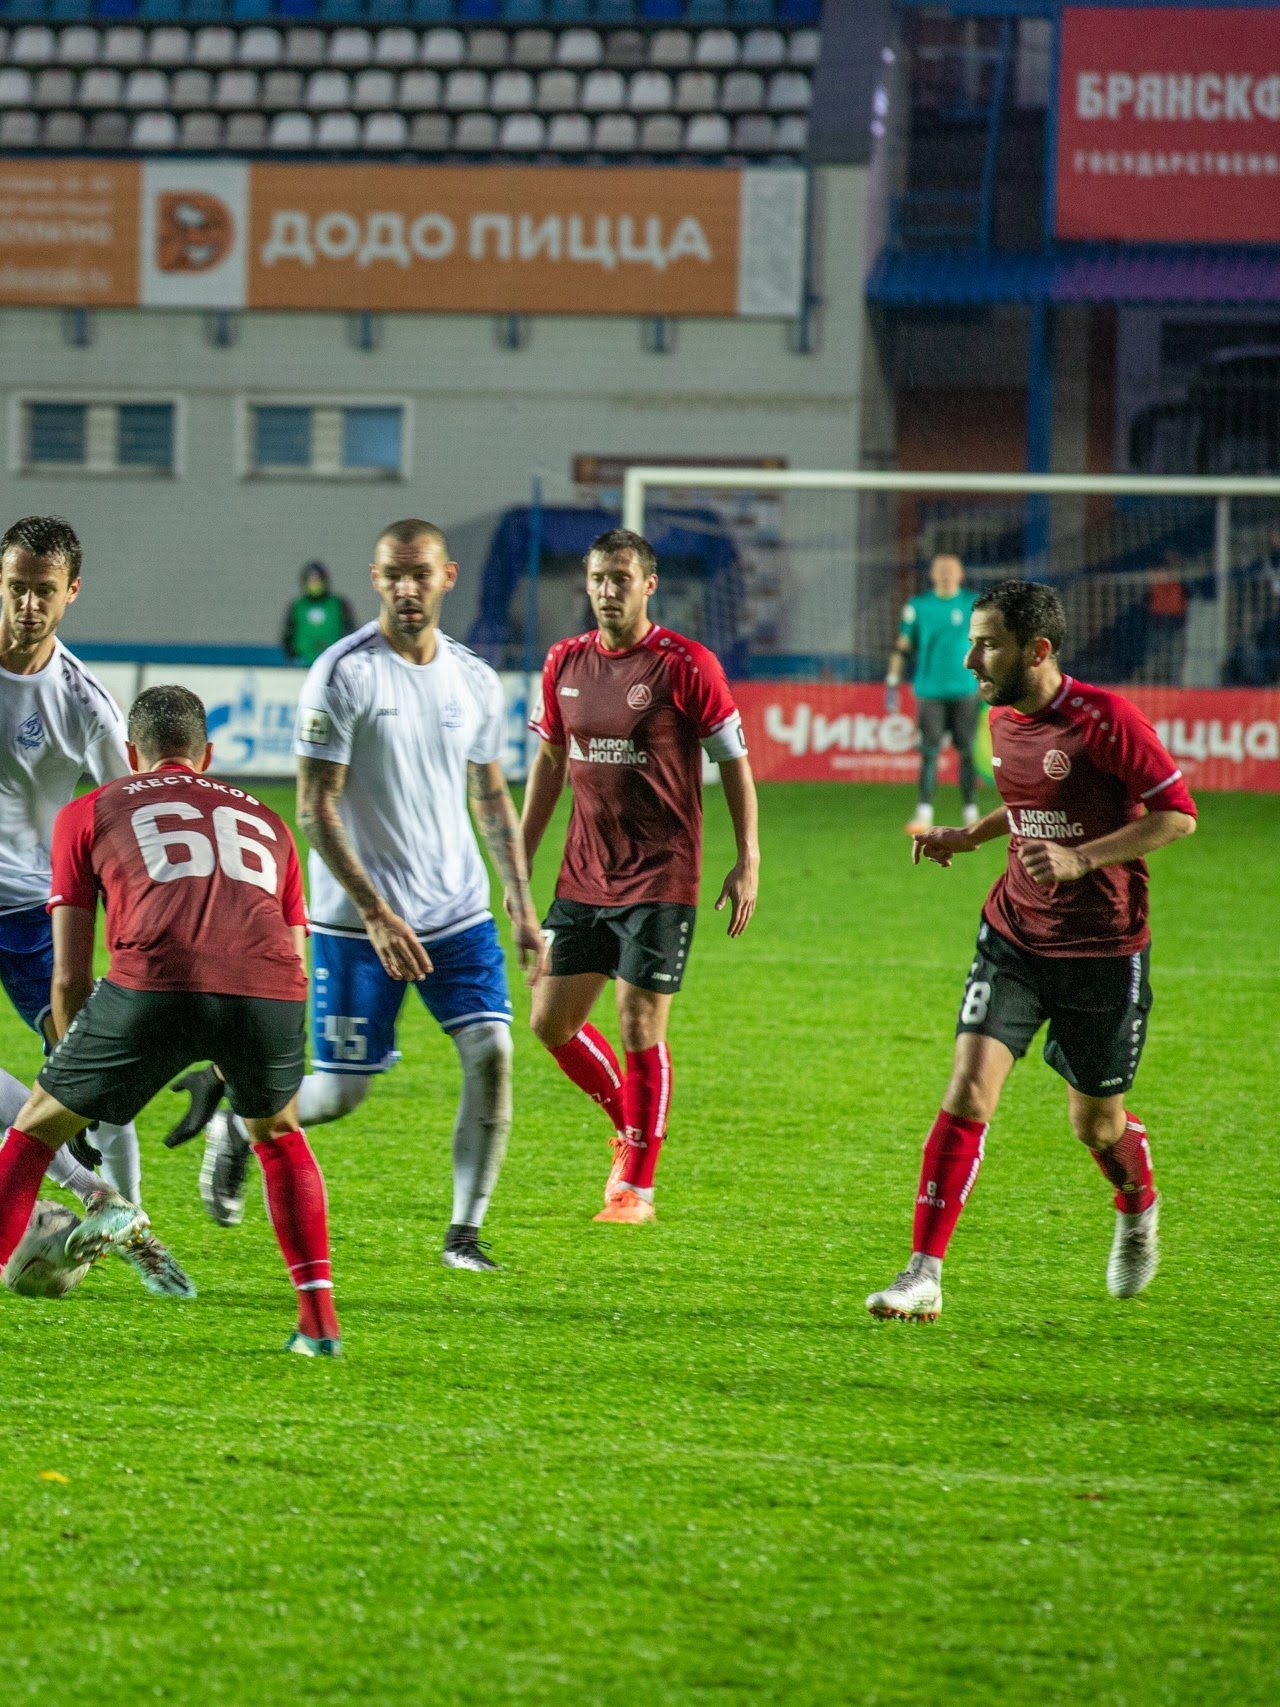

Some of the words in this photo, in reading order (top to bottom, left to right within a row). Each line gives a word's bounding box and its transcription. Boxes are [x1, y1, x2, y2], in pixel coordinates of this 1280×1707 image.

[260, 210, 456, 269] ДОДО
[468, 212, 713, 273] ПИЦЦА
[588, 738, 635, 752] AKRON
[588, 750, 648, 765] HOLDING
[1020, 809, 1068, 824] AKRON
[1020, 822, 1085, 839] HOLDING
[130, 801, 278, 896] 66
[961, 981, 992, 1025] 8
[324, 1015, 369, 1060] 45
